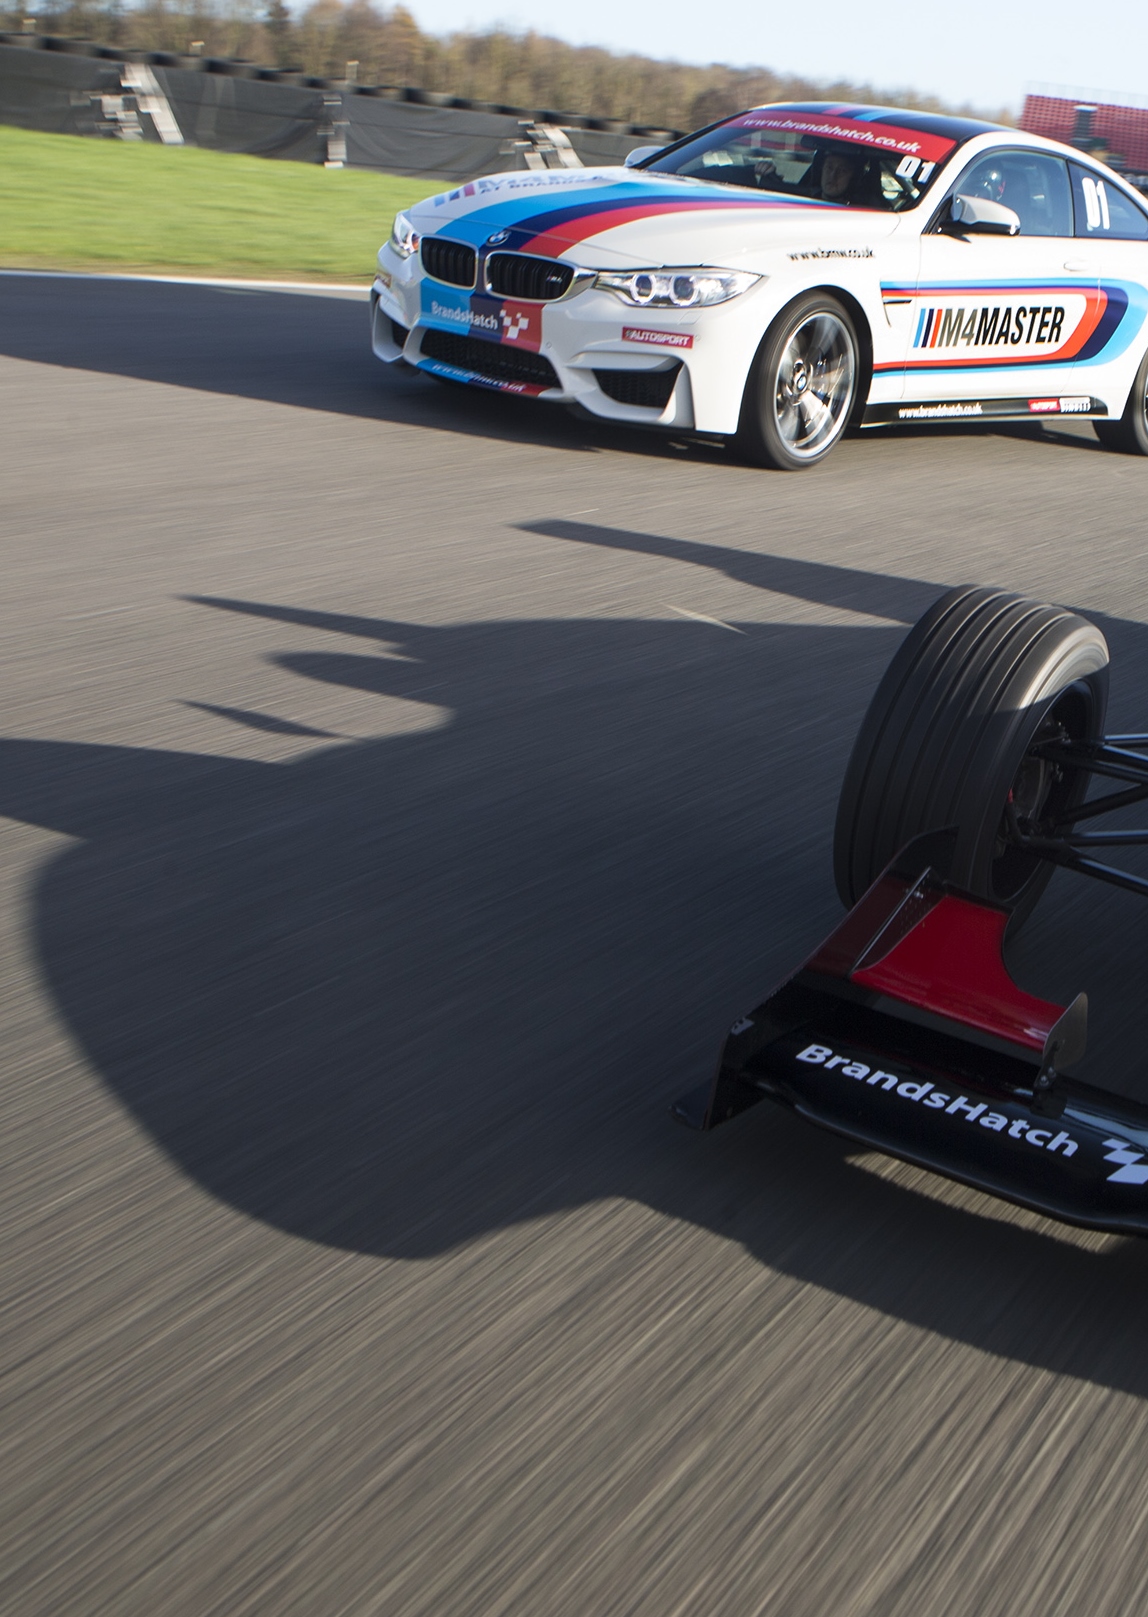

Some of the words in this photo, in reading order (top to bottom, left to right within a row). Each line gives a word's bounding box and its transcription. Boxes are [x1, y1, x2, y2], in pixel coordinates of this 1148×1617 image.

[744, 118, 921, 154] www.brandshatch.co.uk
[896, 154, 937, 185] 01
[1081, 176, 1110, 230] 01
[431, 300, 499, 330] BrandsHatch
[630, 329, 691, 347] AUTOSPORT
[795, 1043, 1079, 1158] BrandsHatch
